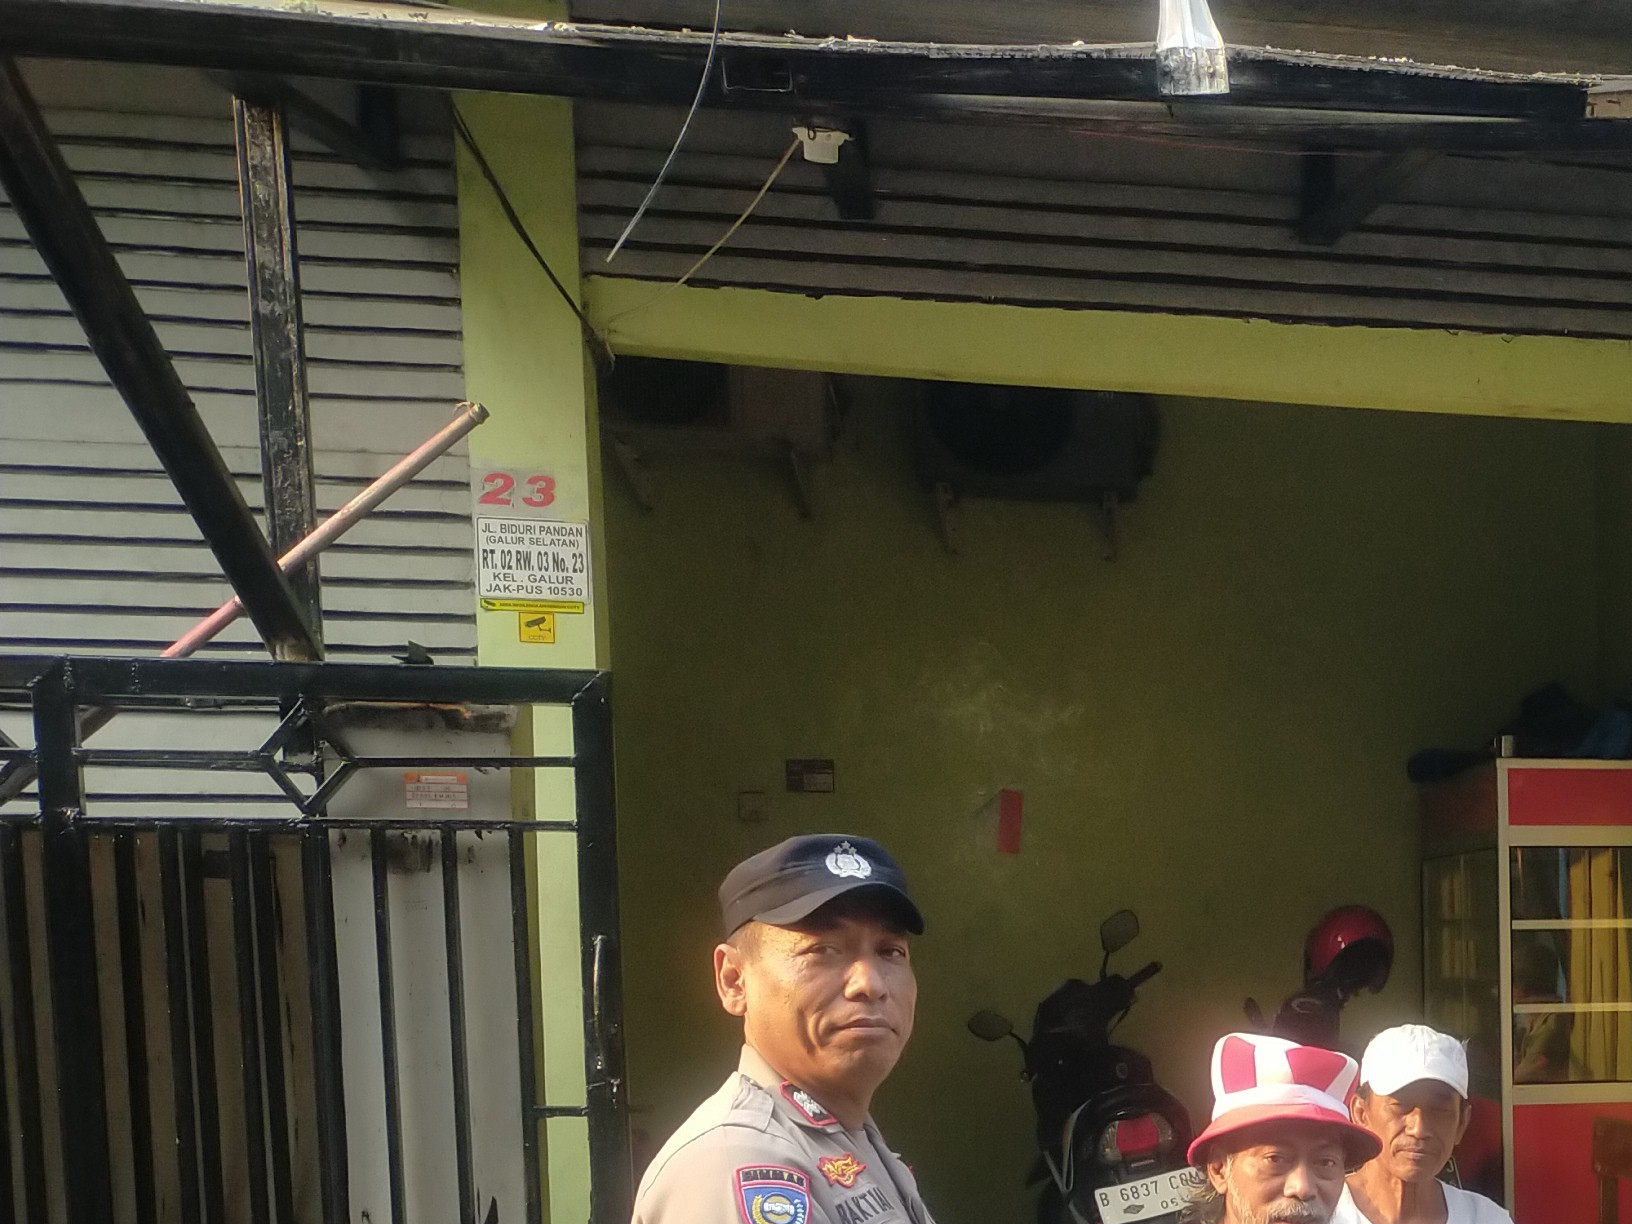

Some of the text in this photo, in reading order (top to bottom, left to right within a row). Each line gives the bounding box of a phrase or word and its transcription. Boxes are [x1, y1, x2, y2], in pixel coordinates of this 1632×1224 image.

[479, 472, 556, 508] 23
[481, 523, 583, 538] JL. BIDURI PANDAN
[485, 535, 580, 549] (GALUR SELATAN)
[482, 549, 585, 574] RT. 02 RW. 03 No. 23
[528, 573, 574, 585] GALUR
[485, 583, 583, 597] JAK-PUS 10530
[1099, 1192, 1110, 1207] B
[1119, 1180, 1159, 1202] 6837
